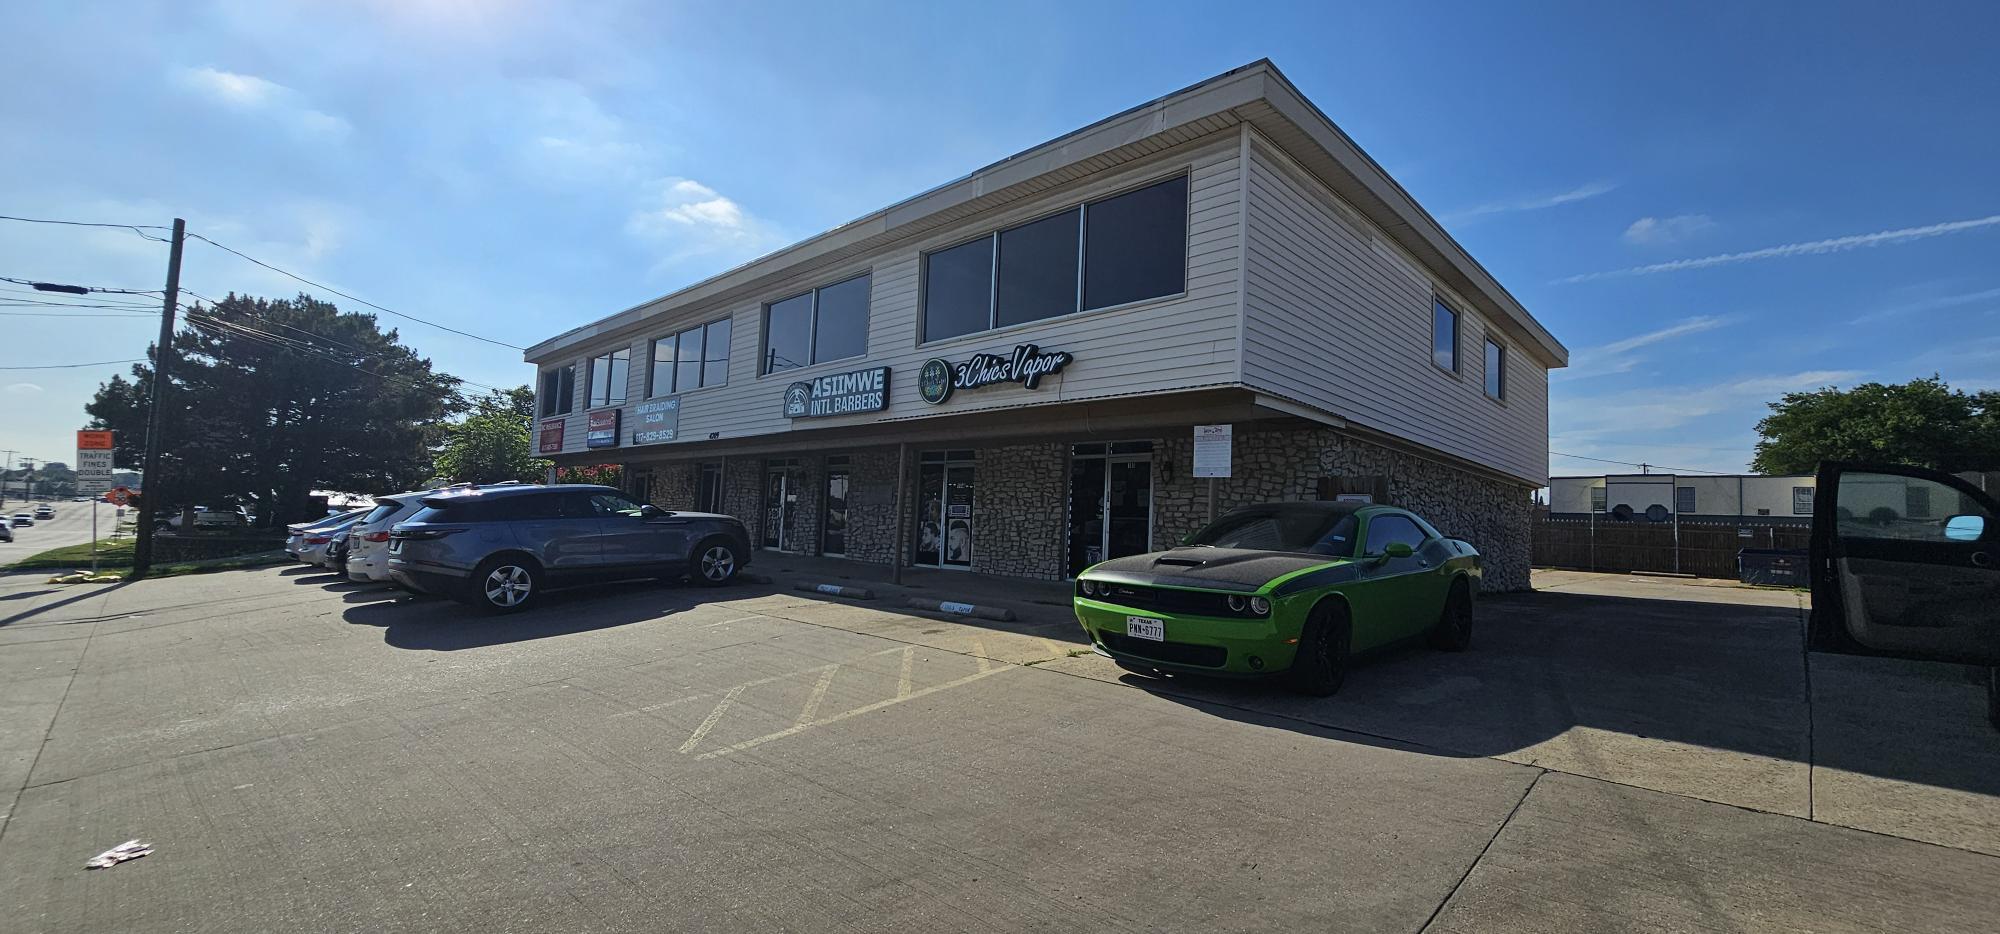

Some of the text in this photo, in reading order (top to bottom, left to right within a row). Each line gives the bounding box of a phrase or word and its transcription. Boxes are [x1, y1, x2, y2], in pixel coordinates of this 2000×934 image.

[1010, 345, 1065, 387] Vapor
[811, 368, 885, 399] ASIIMWE
[810, 398, 833, 416] INTL
[834, 391, 883, 413] BARBERS
[645, 412, 664, 423] SALON
[79, 452, 111, 460] TRAFFIC
